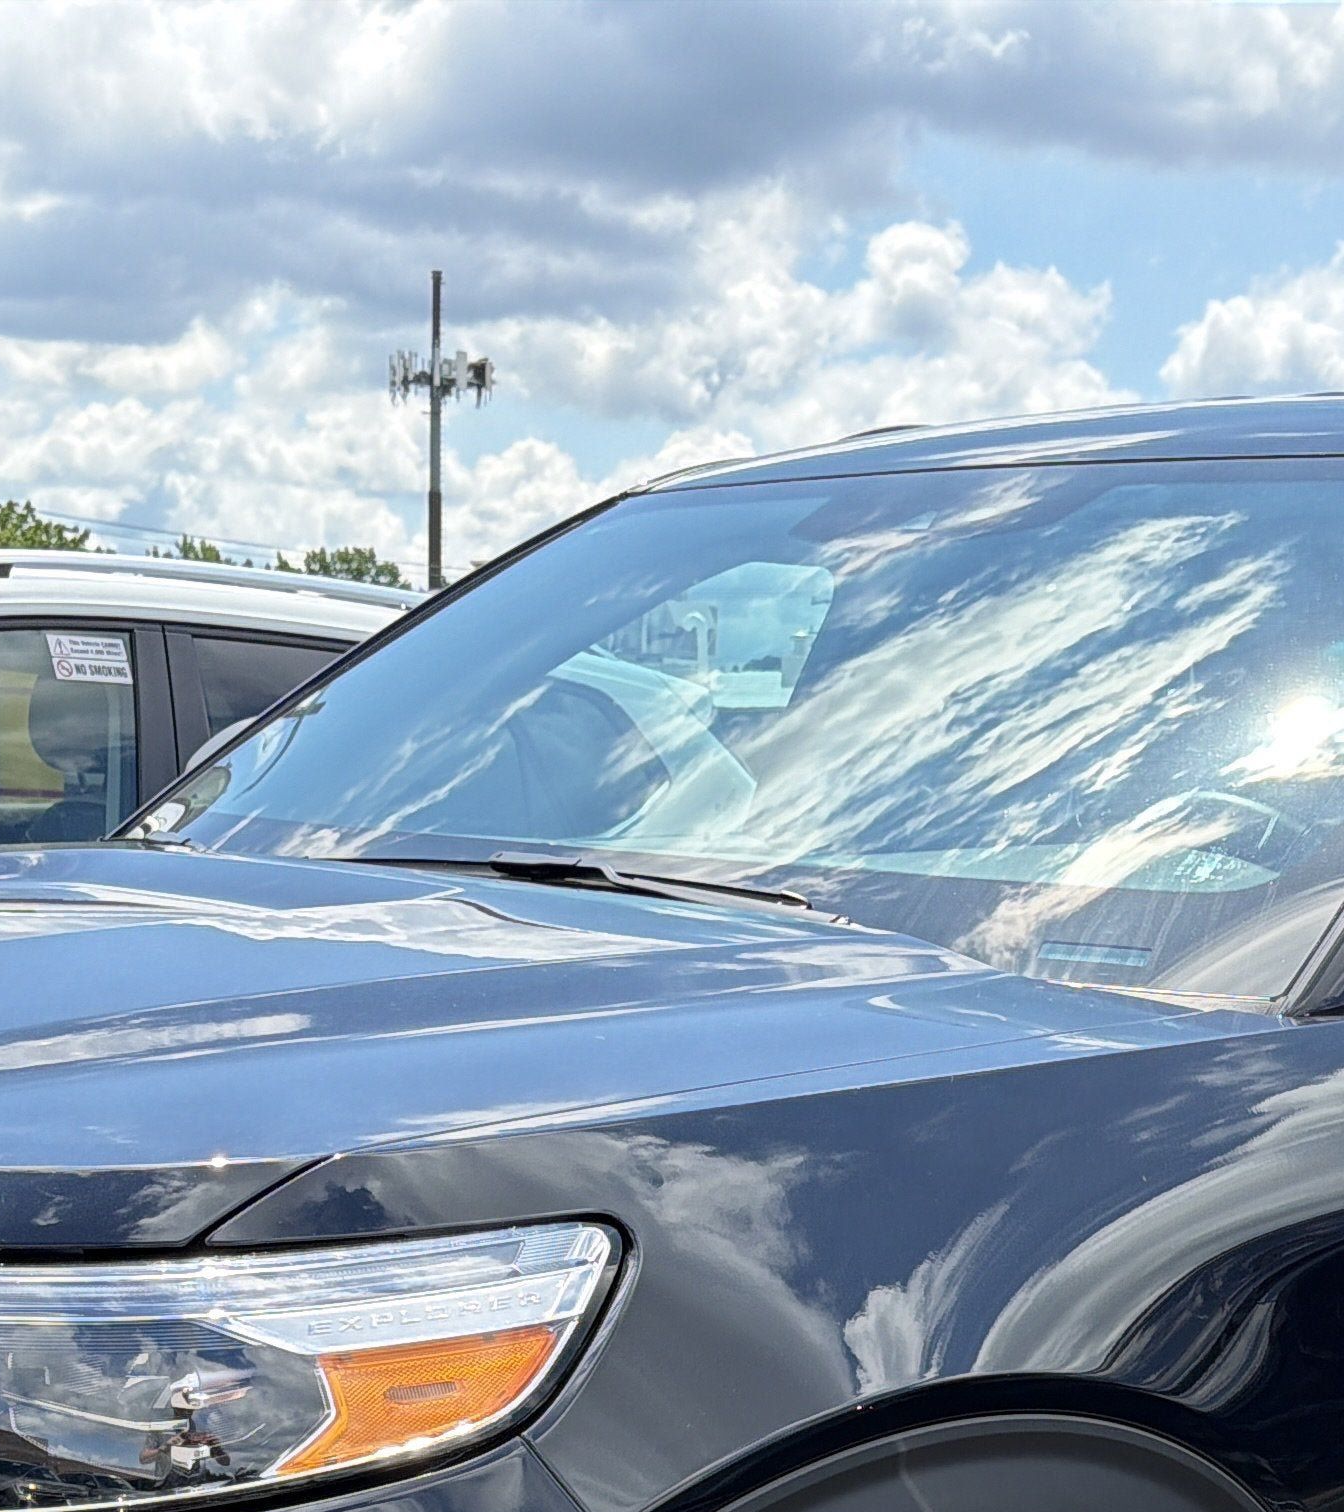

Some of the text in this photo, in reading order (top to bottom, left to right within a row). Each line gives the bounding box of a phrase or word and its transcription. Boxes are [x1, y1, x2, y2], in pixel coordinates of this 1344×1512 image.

[74, 663, 128, 678] NO SMOKING
[308, 1291, 542, 1336] EXPLORER
